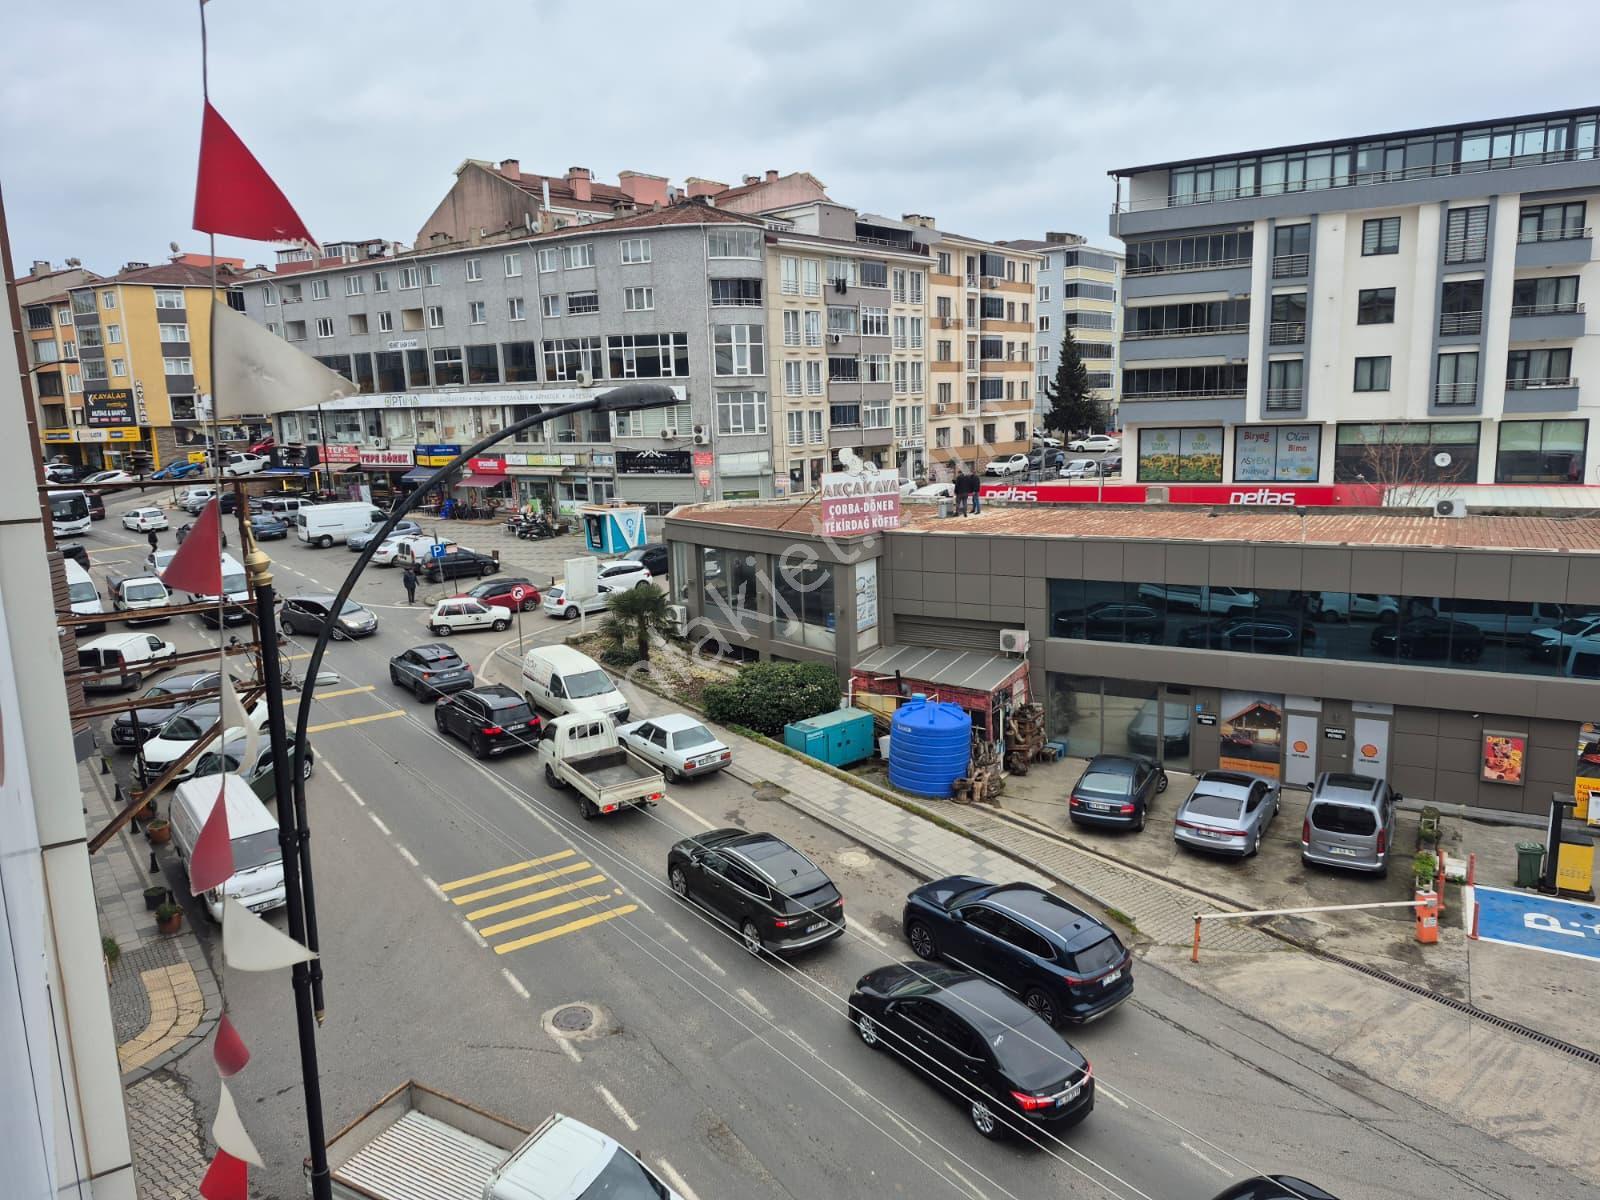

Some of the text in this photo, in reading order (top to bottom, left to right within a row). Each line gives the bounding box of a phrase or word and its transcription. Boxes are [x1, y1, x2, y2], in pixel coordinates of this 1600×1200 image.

[823, 480, 898, 498] AKÇAKAYA
[824, 514, 899, 533] TEKİRDAĞ KÖFTE
[433, 545, 443, 557] P
